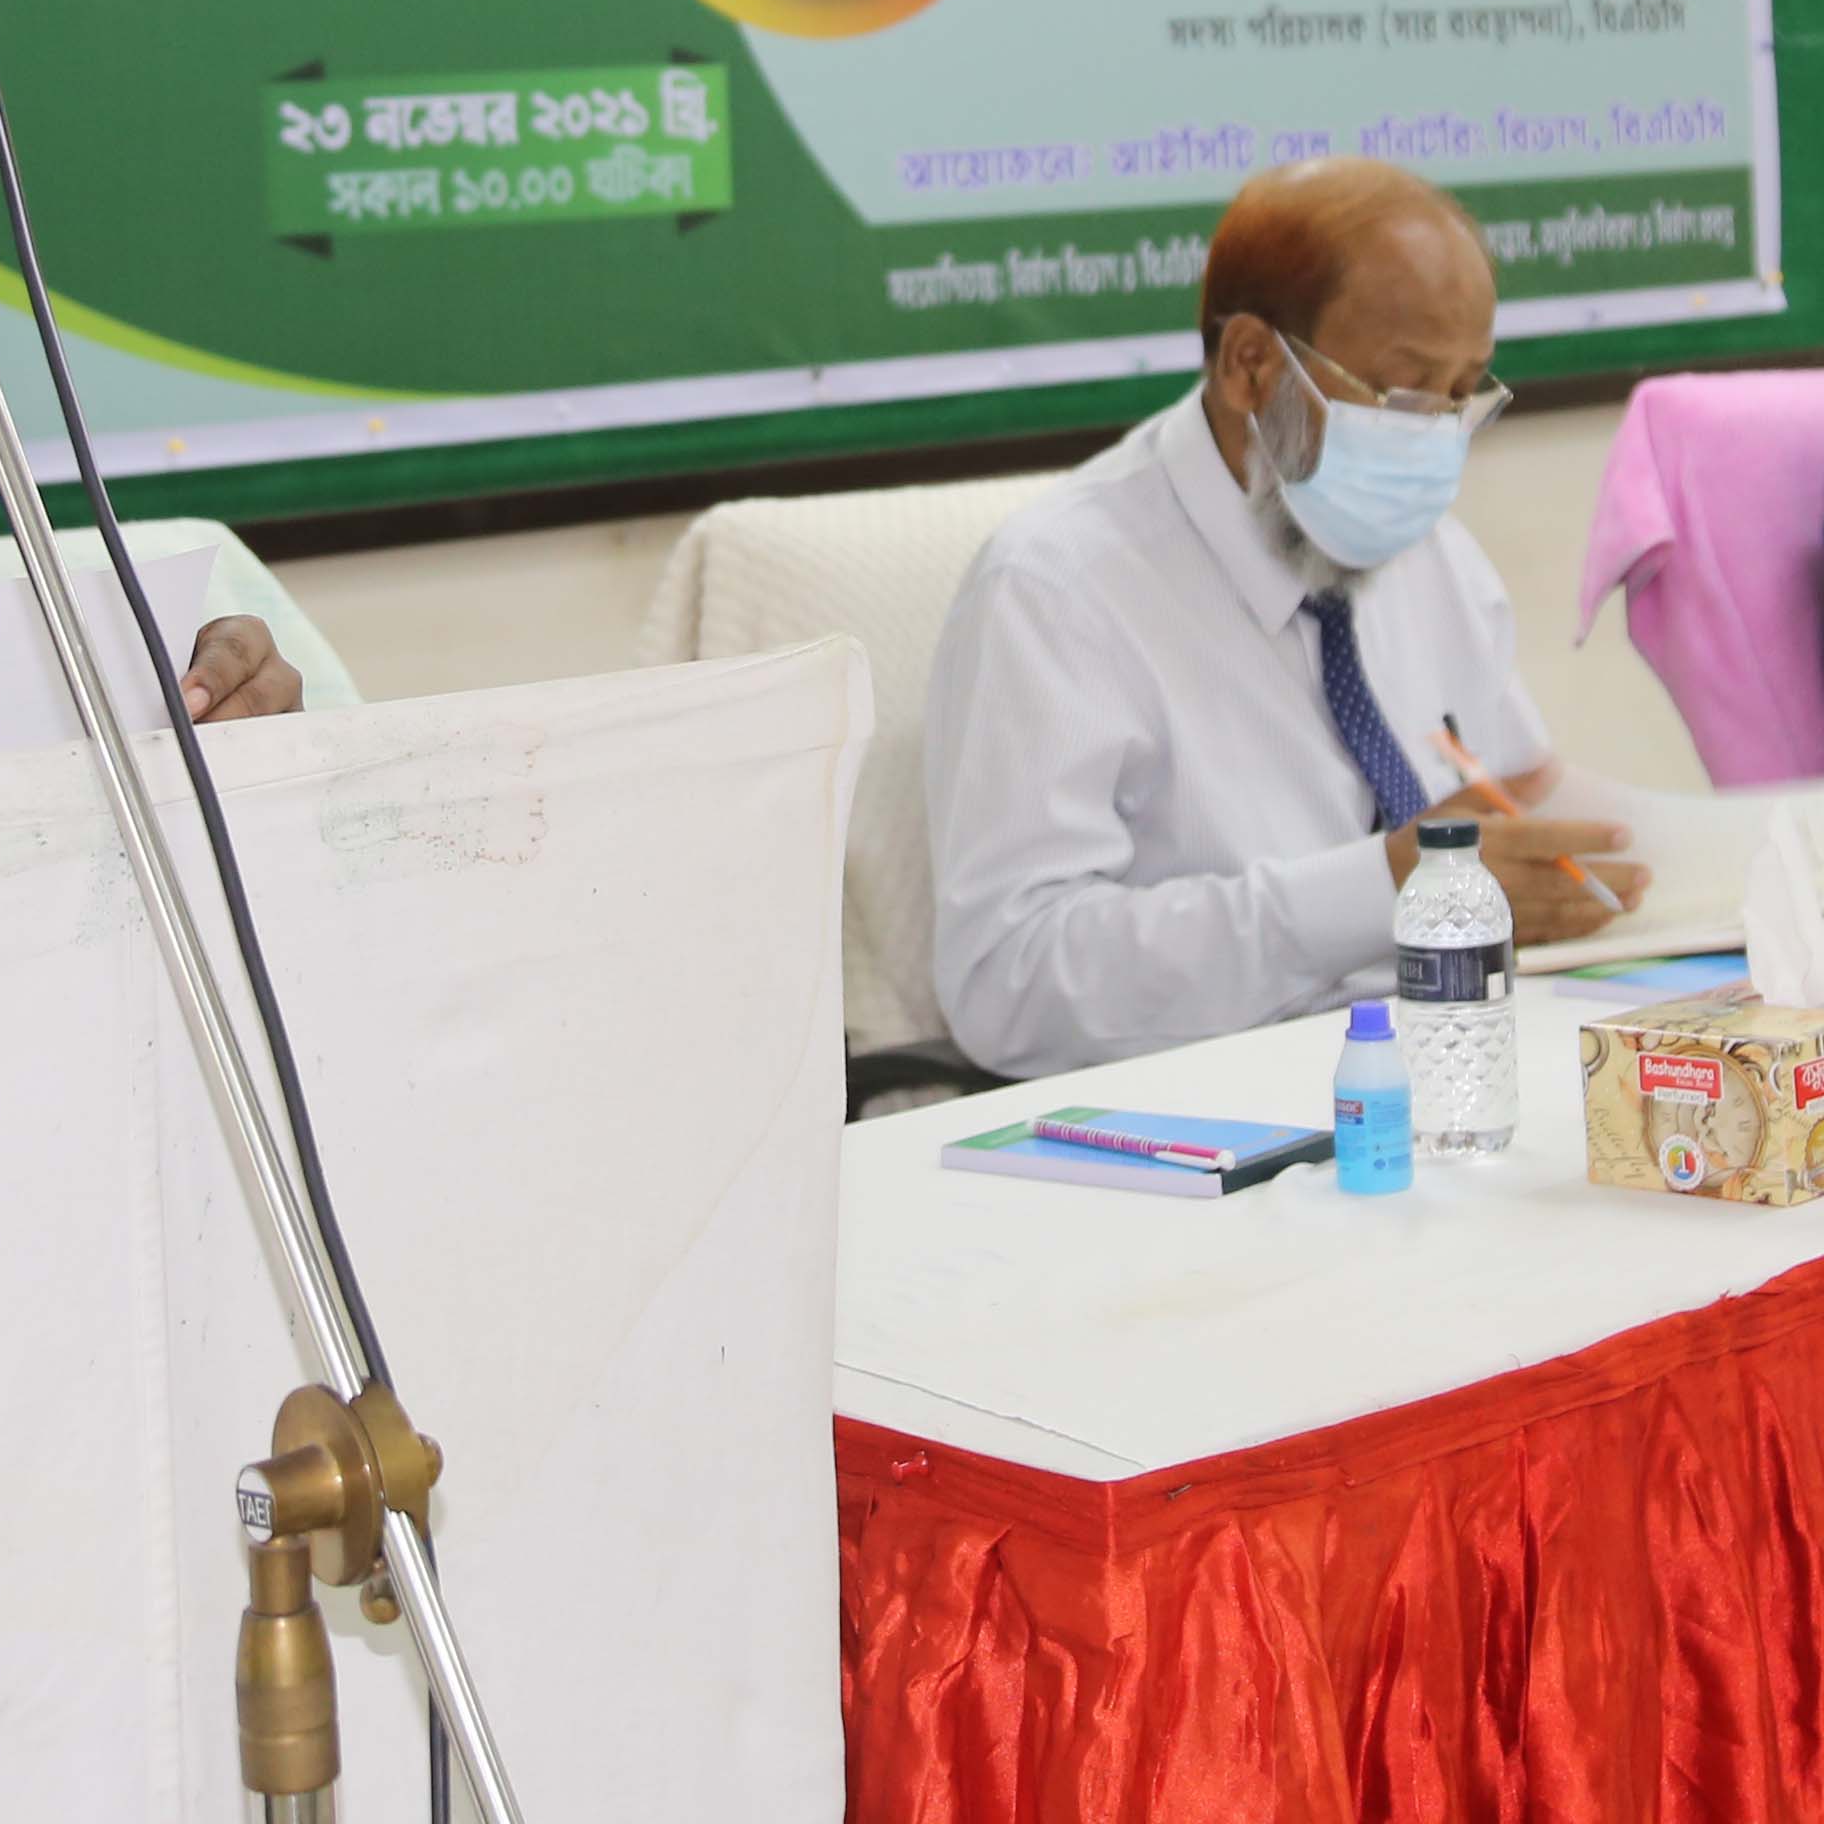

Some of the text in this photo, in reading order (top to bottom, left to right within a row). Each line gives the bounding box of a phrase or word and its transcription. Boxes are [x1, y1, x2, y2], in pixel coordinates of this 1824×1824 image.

[280, 101, 352, 153] ২৩
[363, 91, 519, 151] নভেম্বর
[531, 88, 650, 138] ২০২১
[327, 142, 694, 219] সকাল ১০.০০ ঘটিকা
[1644, 1058, 1715, 1081] Bashundhara
